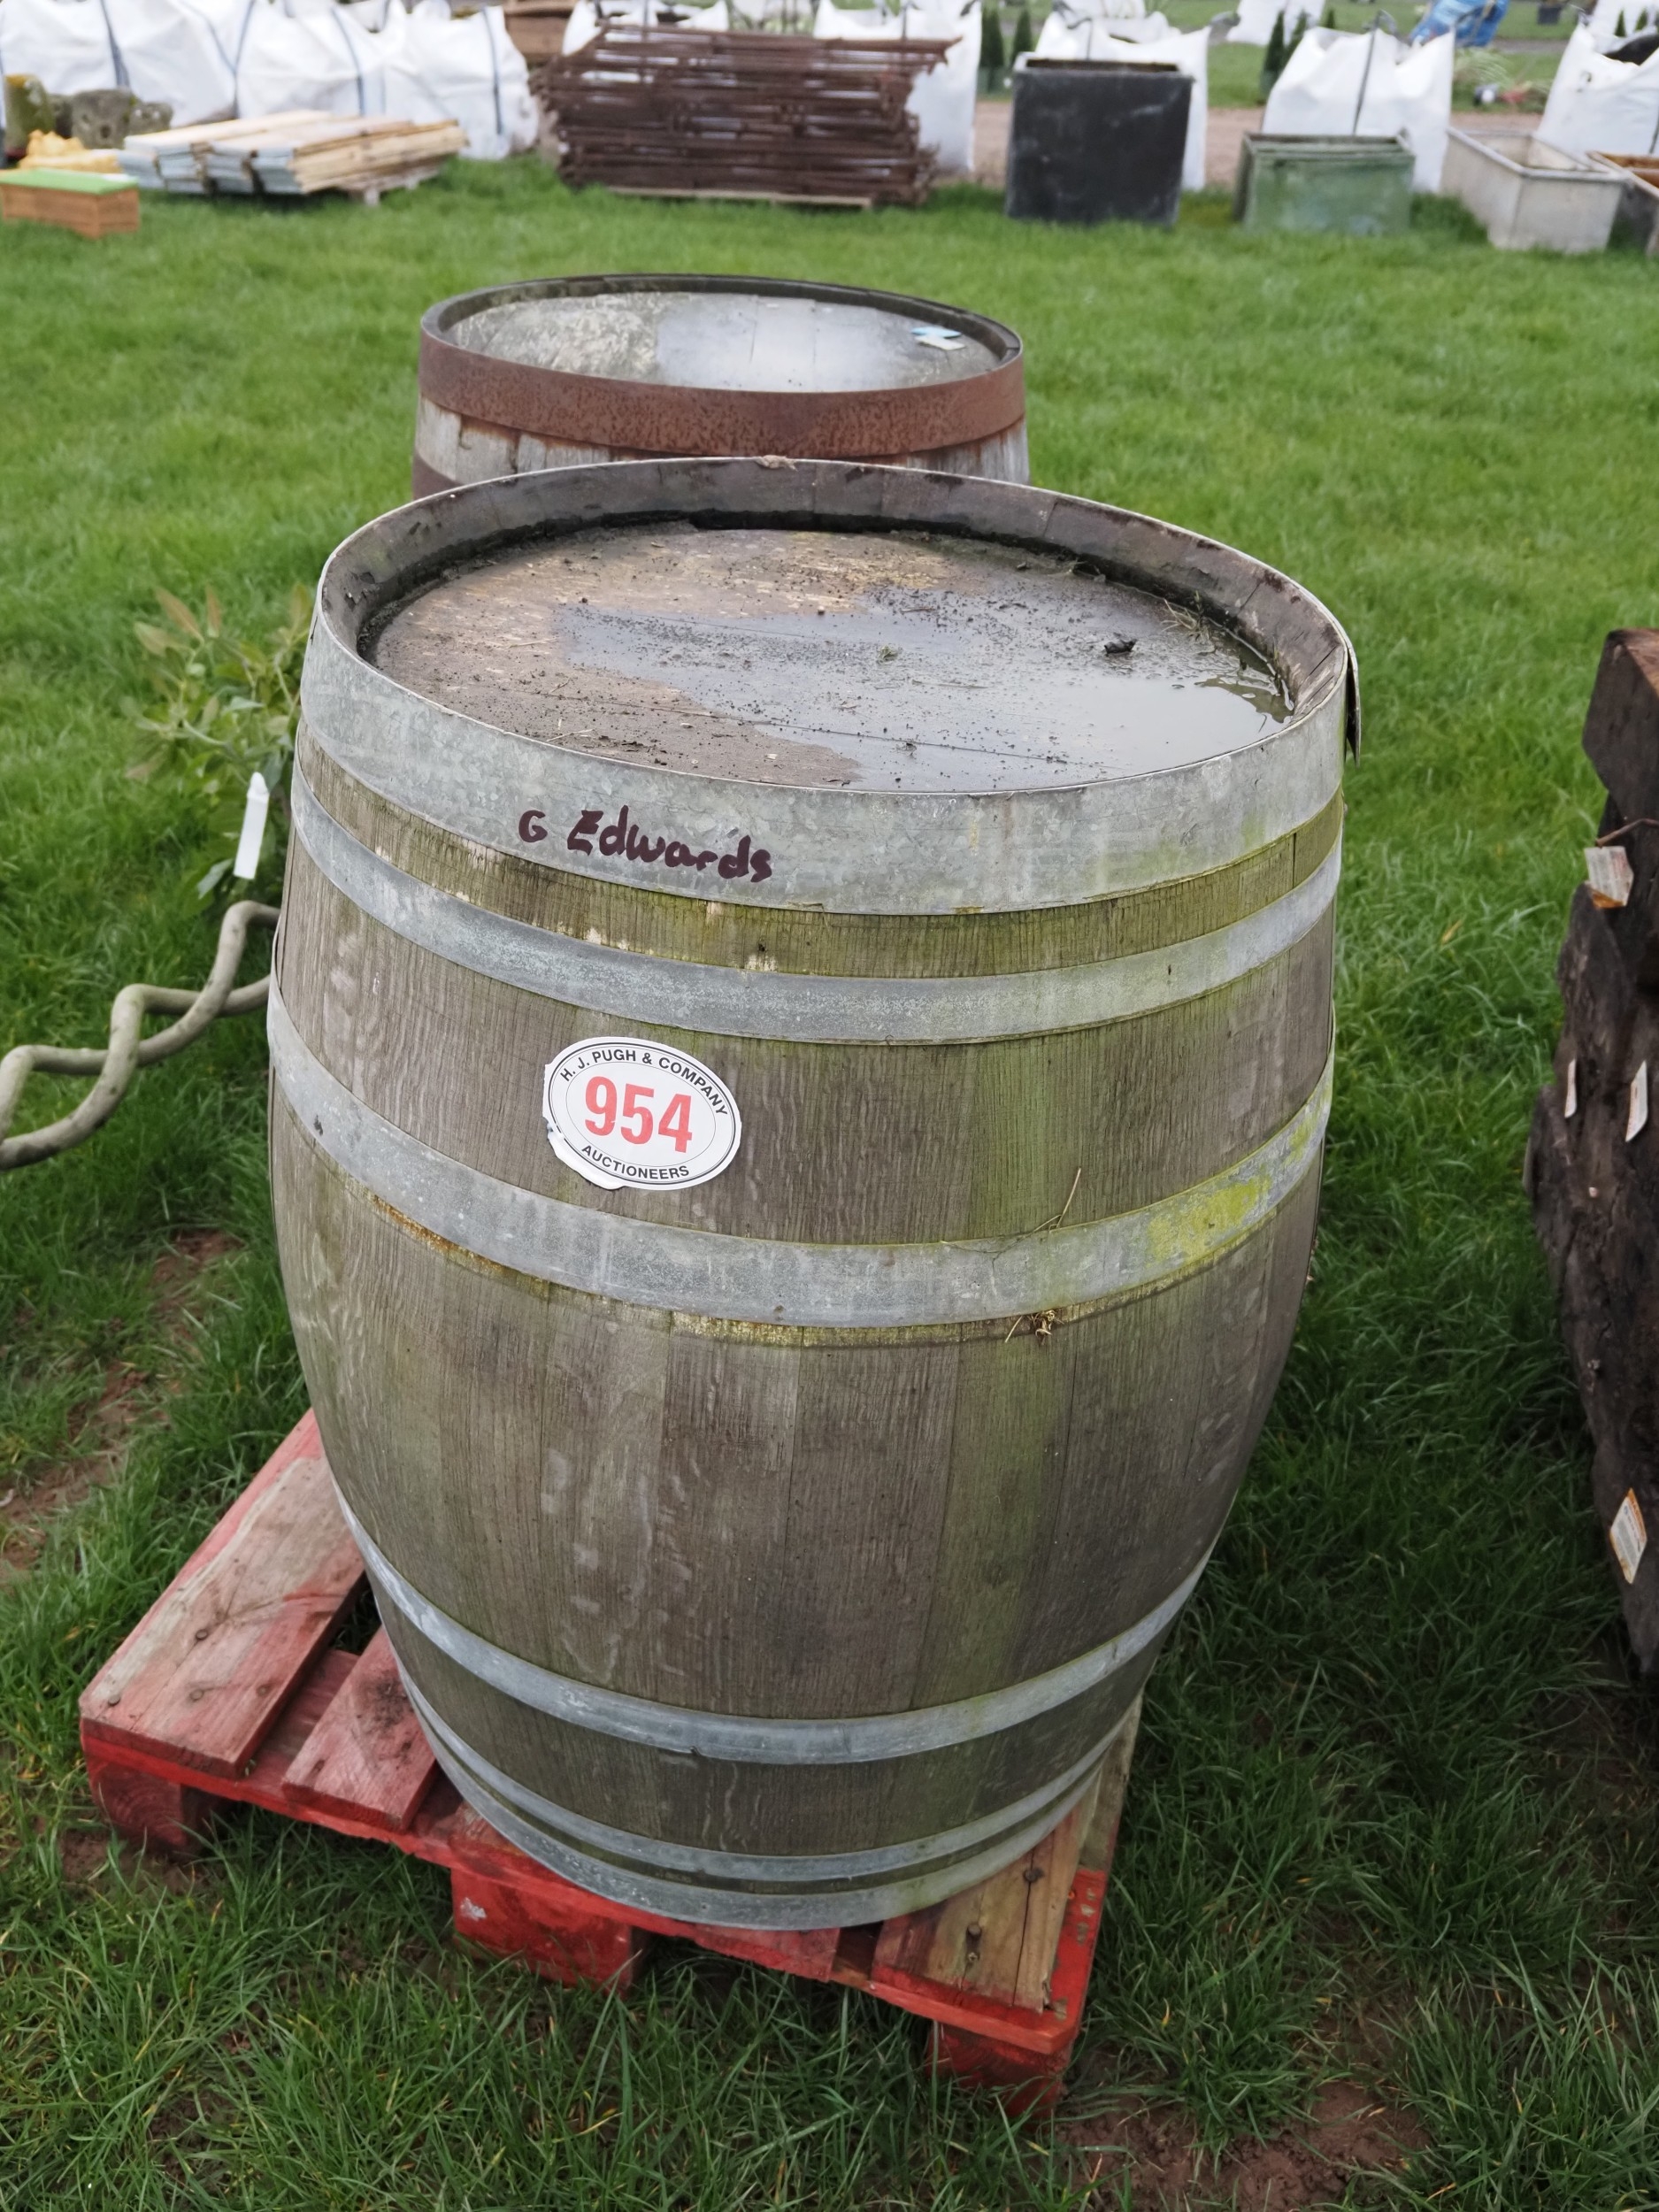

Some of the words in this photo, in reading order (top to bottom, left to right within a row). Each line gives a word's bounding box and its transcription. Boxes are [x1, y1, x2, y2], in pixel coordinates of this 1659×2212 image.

[518, 810, 548, 842] G
[567, 804, 772, 883] Edwards
[585, 1076, 693, 1153] 954
[592, 1049, 636, 1063] PUGH
[642, 1052, 652, 1064] &
[658, 1056, 728, 1116] COMPANY
[581, 1145, 690, 1179] AUCTIONEERS
